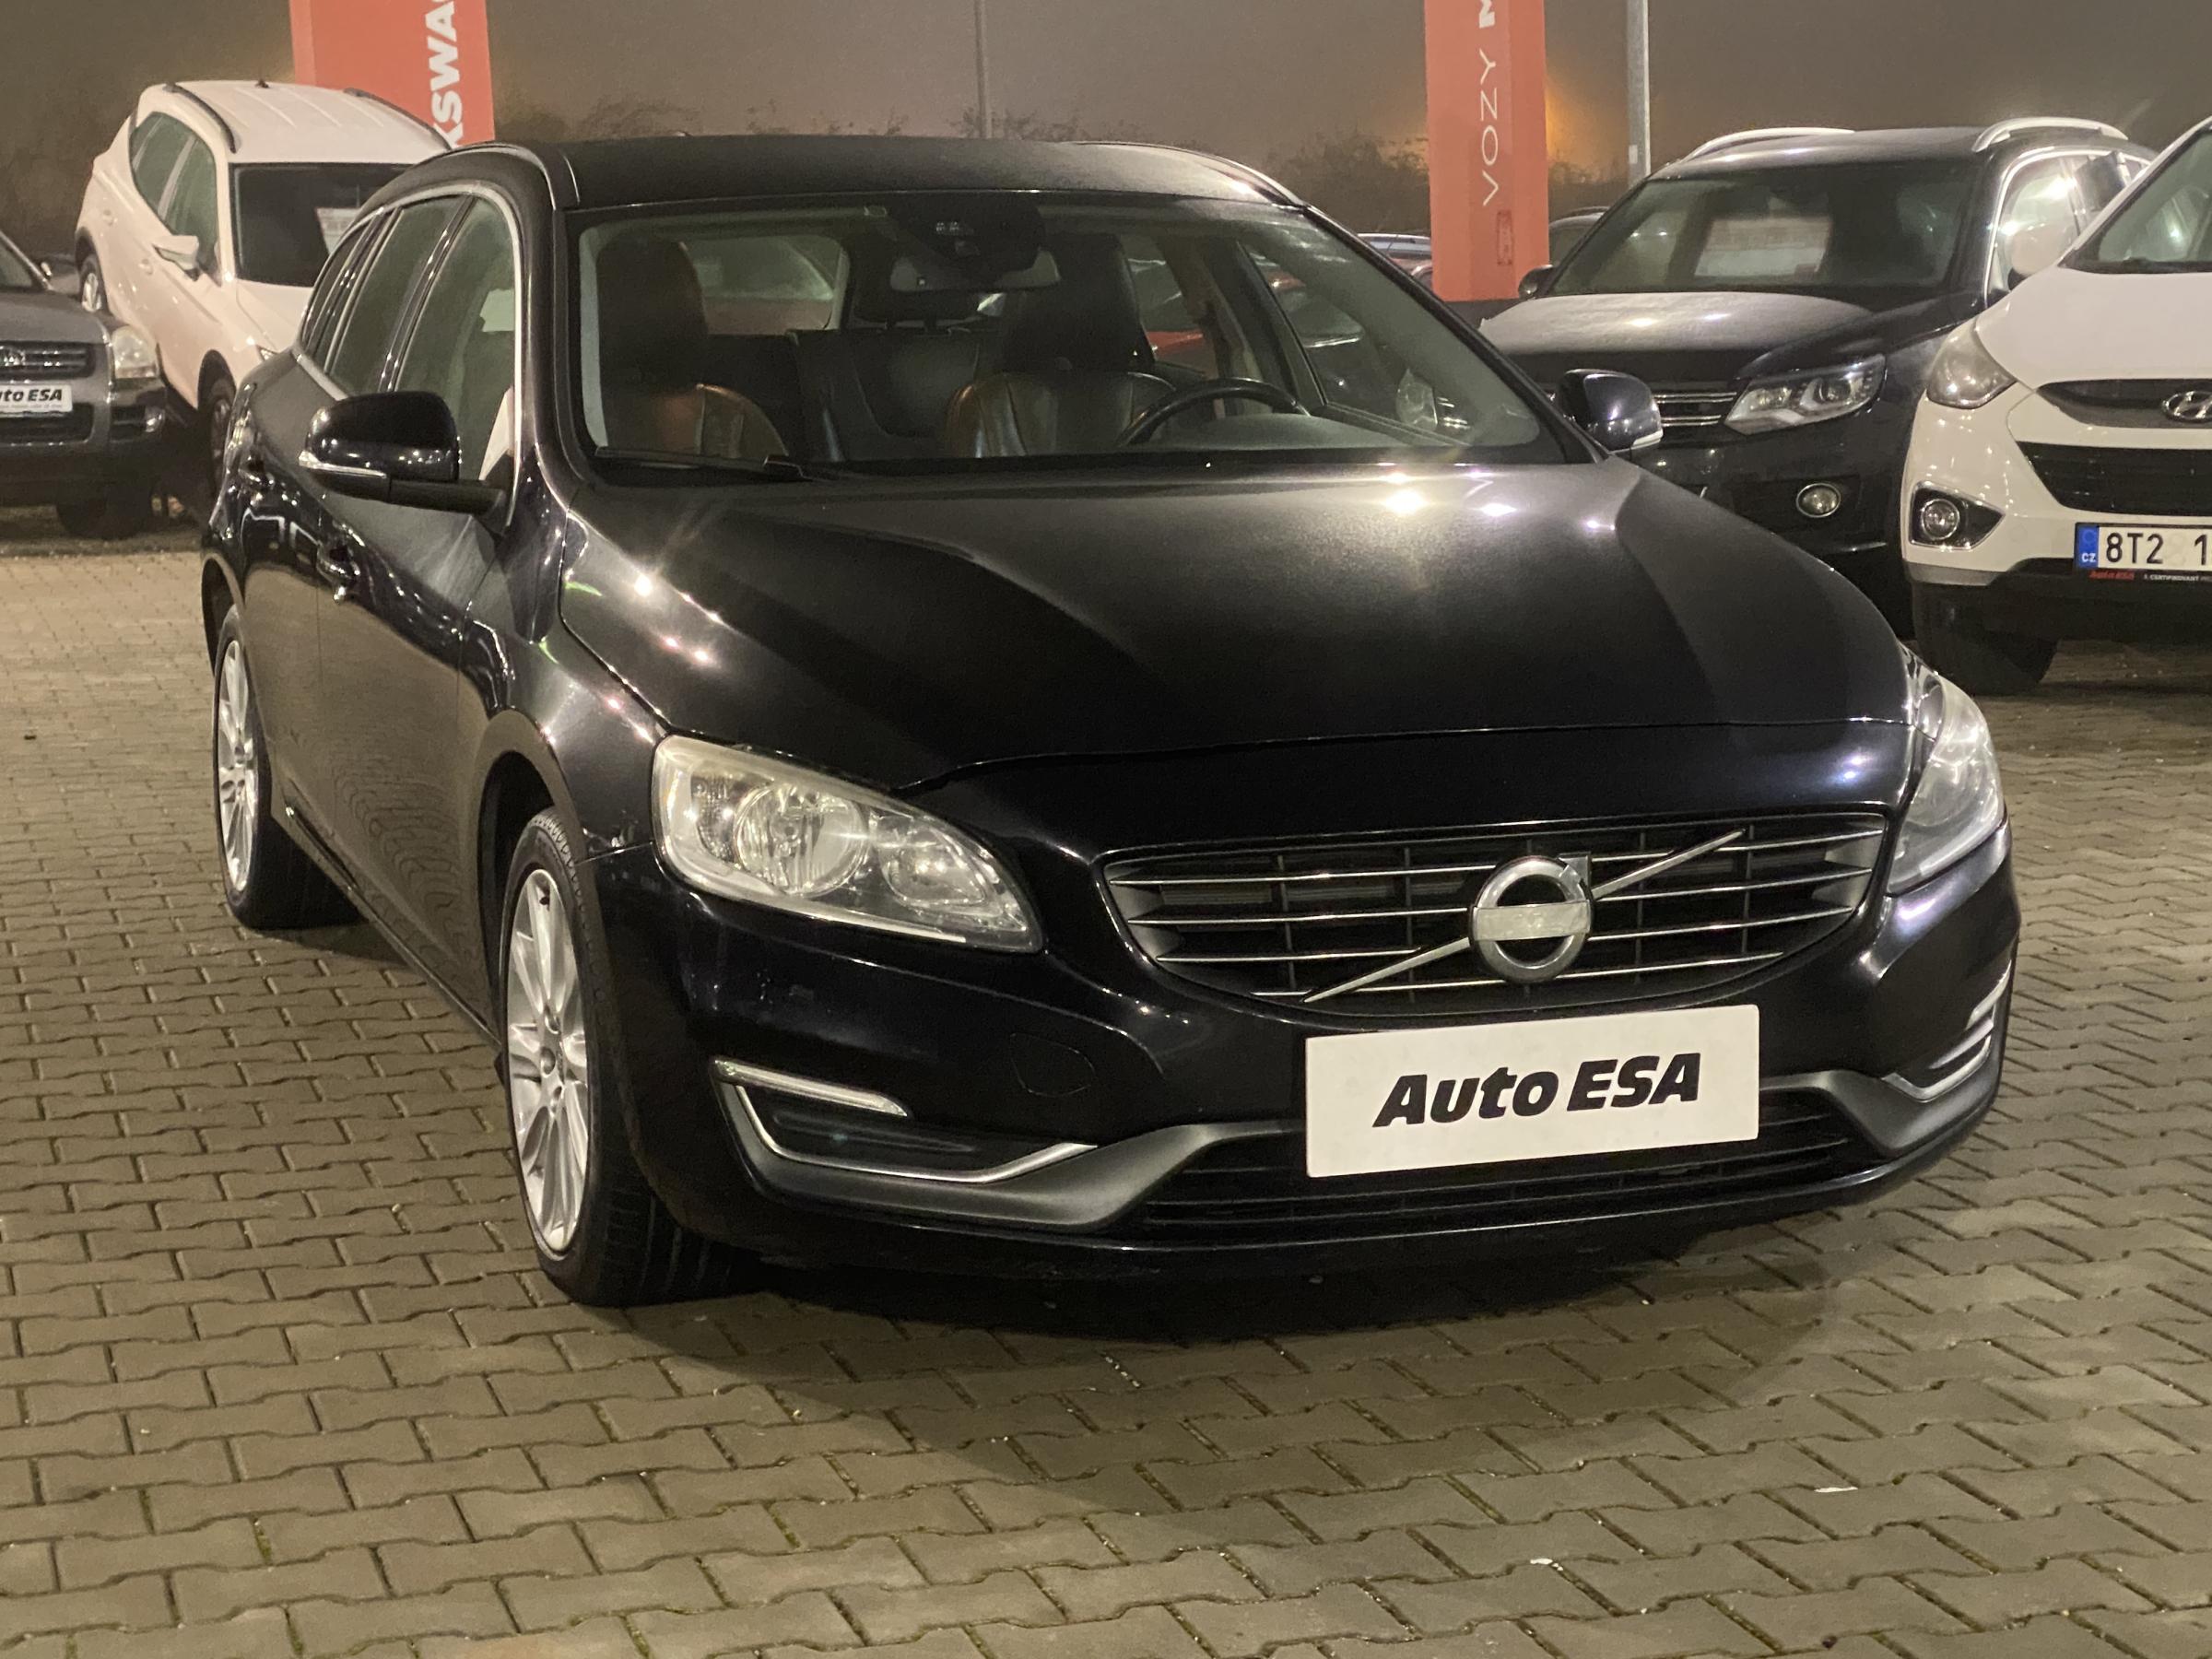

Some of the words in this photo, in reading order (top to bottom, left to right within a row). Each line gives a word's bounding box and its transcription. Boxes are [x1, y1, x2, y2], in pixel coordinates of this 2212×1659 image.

[425, 0, 464, 148] KSWA
[1479, 48, 1499, 206] VOZY
[28, 388, 63, 402] ESA
[2081, 552, 2097, 563] CZ
[2106, 532, 2164, 564] 8T2
[1371, 1066, 1559, 1128] Auto
[1566, 1053, 1700, 1112] ESA
